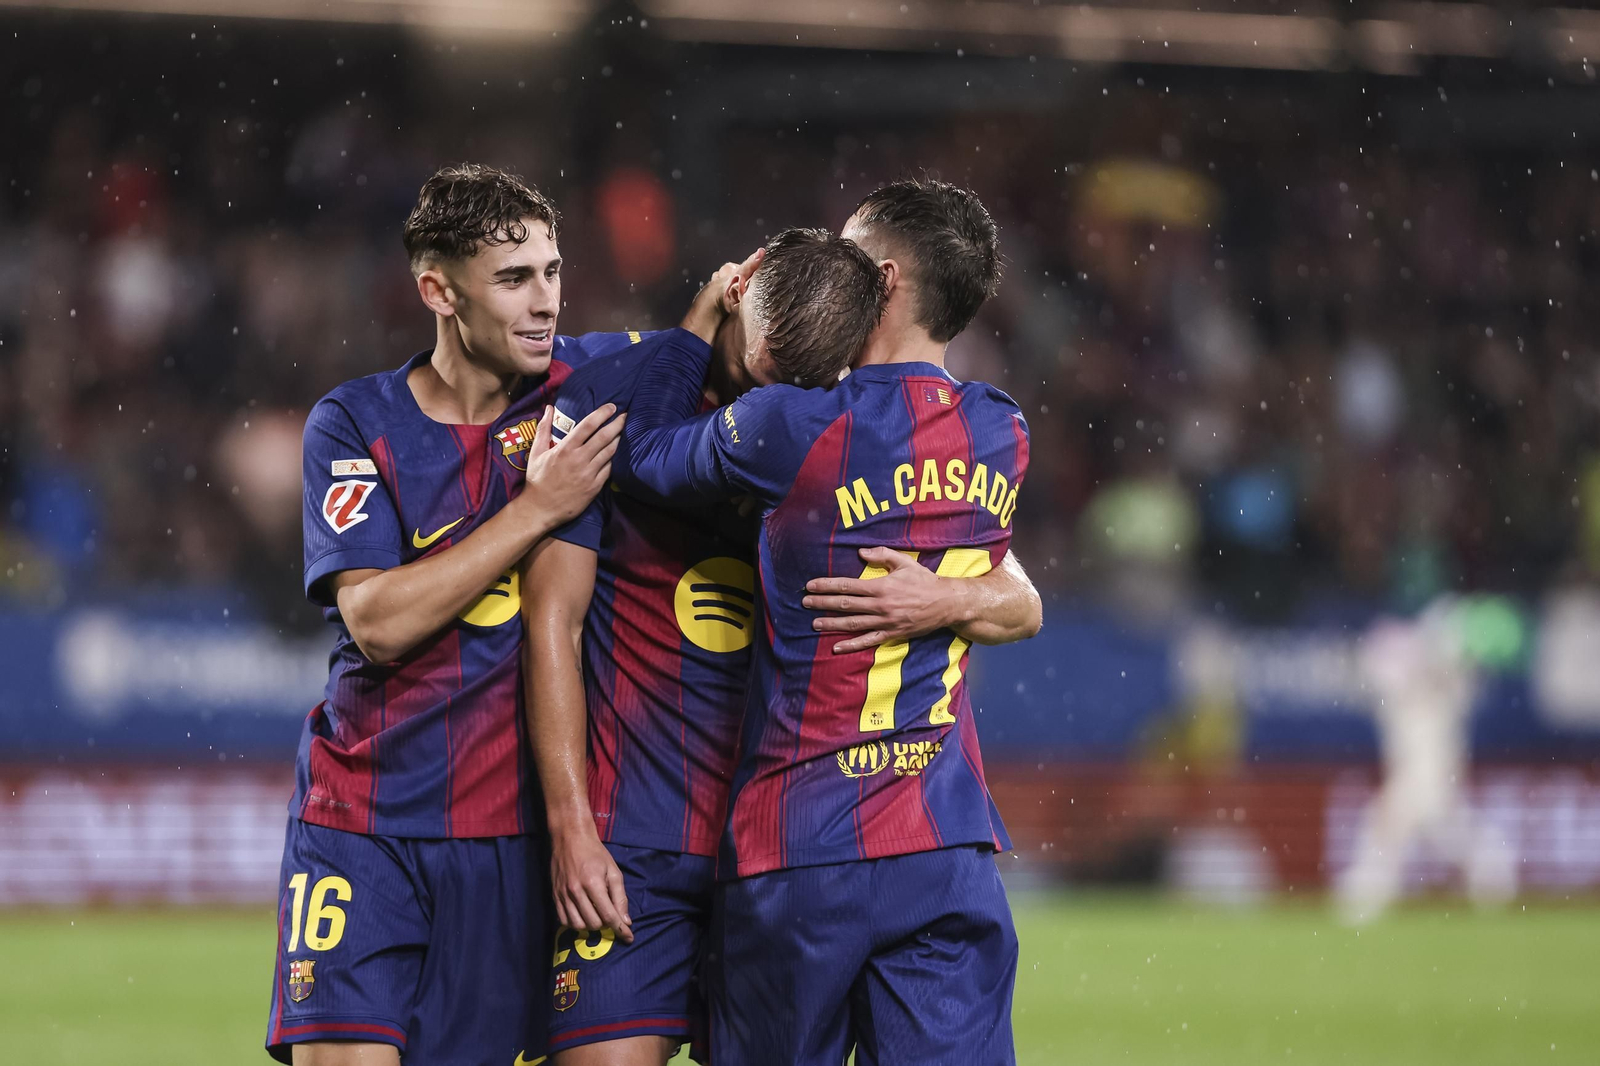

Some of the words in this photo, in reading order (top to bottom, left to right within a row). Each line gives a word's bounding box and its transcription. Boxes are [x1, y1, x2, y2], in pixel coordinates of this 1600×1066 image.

[834, 477, 890, 529] M.
[893, 458, 1020, 529] CASADÓ
[287, 873, 353, 953] 16
